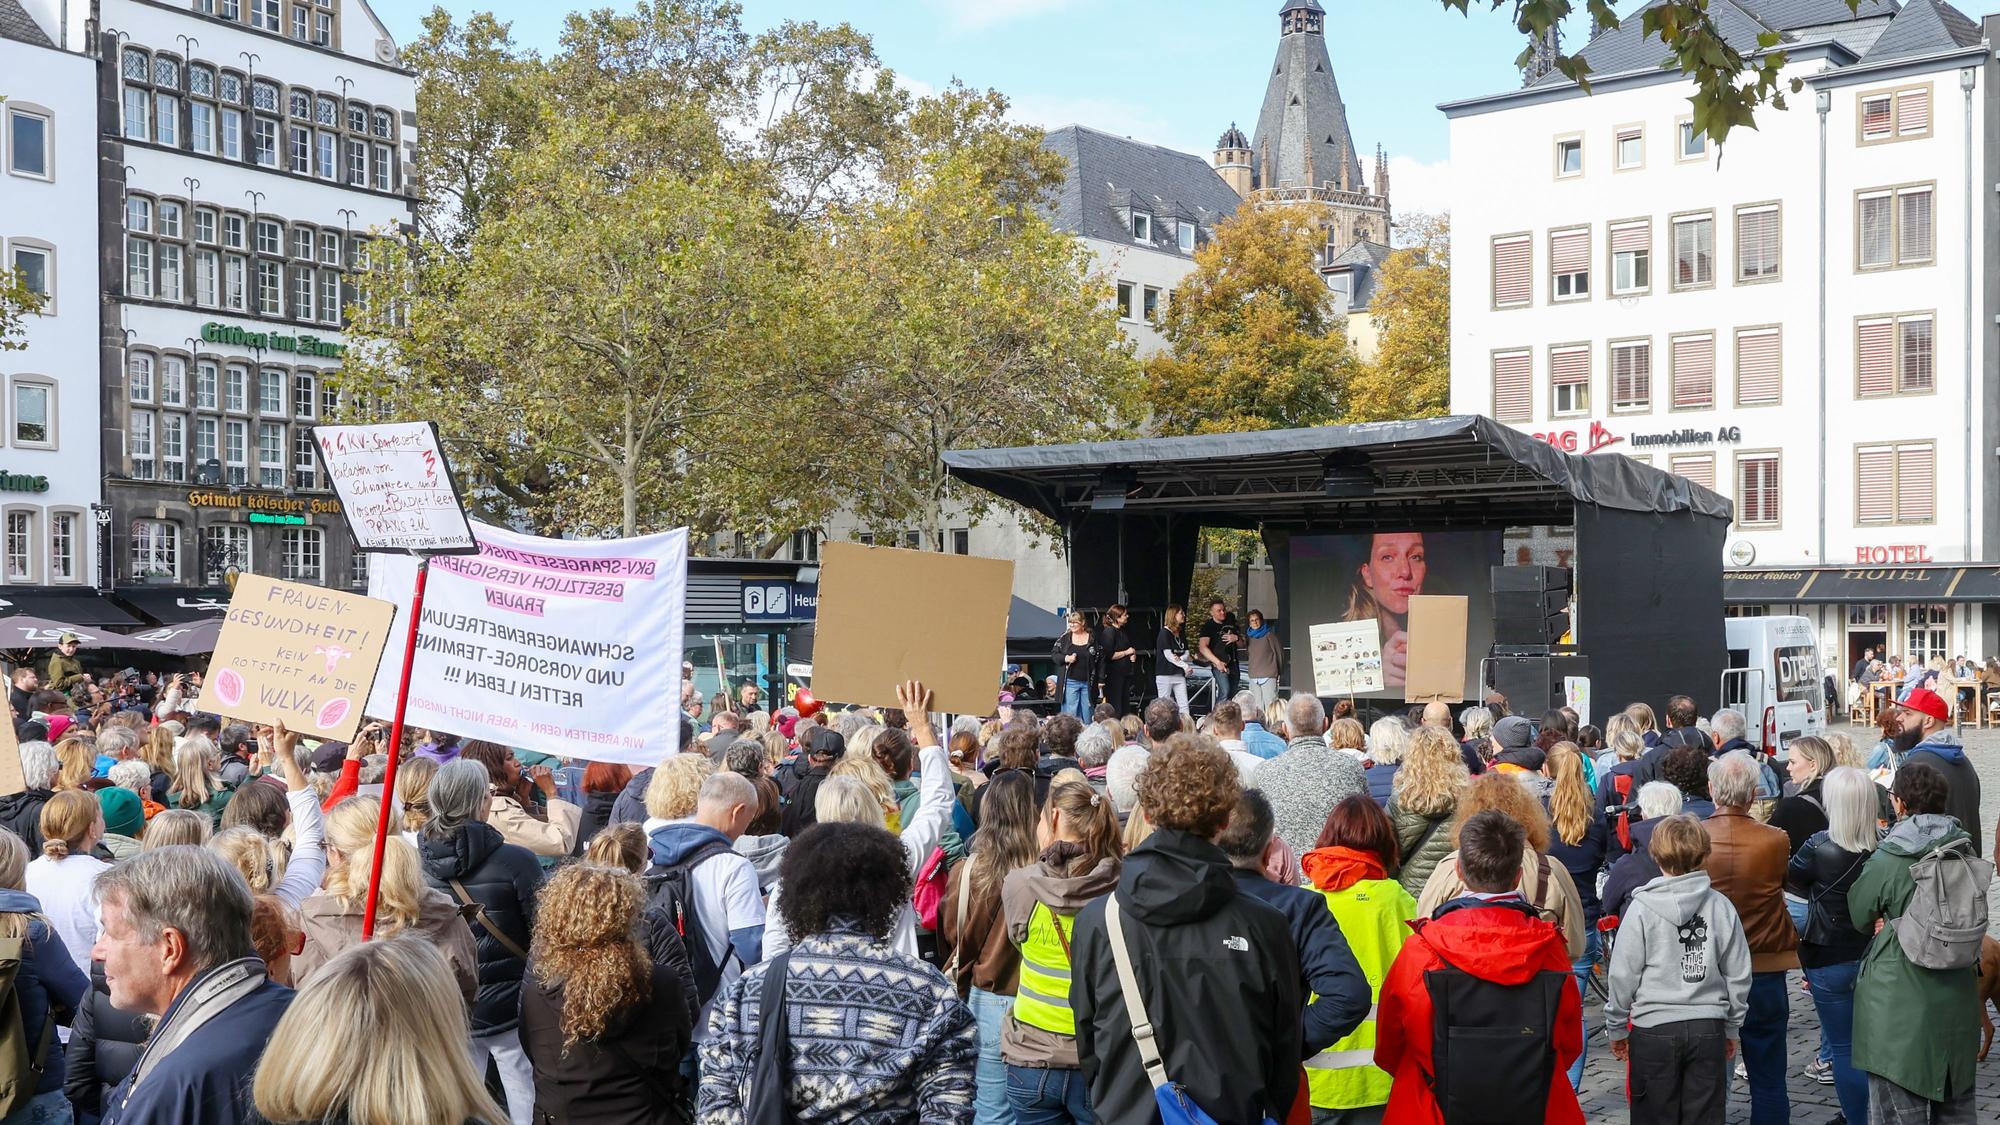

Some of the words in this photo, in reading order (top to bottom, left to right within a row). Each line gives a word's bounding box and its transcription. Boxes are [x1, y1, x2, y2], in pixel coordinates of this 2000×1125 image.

[201, 321, 268, 348] Gilden
[269, 331, 297, 352] im
[1631, 428, 1713, 447] Immobilien
[1717, 426, 1741, 442] AG
[188, 491, 242, 508] Heimat
[248, 494, 305, 513] kölscher
[311, 498, 341, 514] Held
[364, 536, 388, 547] KEINE
[1855, 544, 1933, 564] HOTEL
[1840, 569, 1932, 581] HOTEL
[267, 585, 351, 616] FRAUEN-
[795, 594, 818, 607] Heu
[276, 646, 310, 662] KEIN
[232, 656, 303, 677] ROTSTIFT
[309, 673, 328, 686] AN
[334, 678, 358, 694] DIE
[260, 683, 315, 717] VULVA
